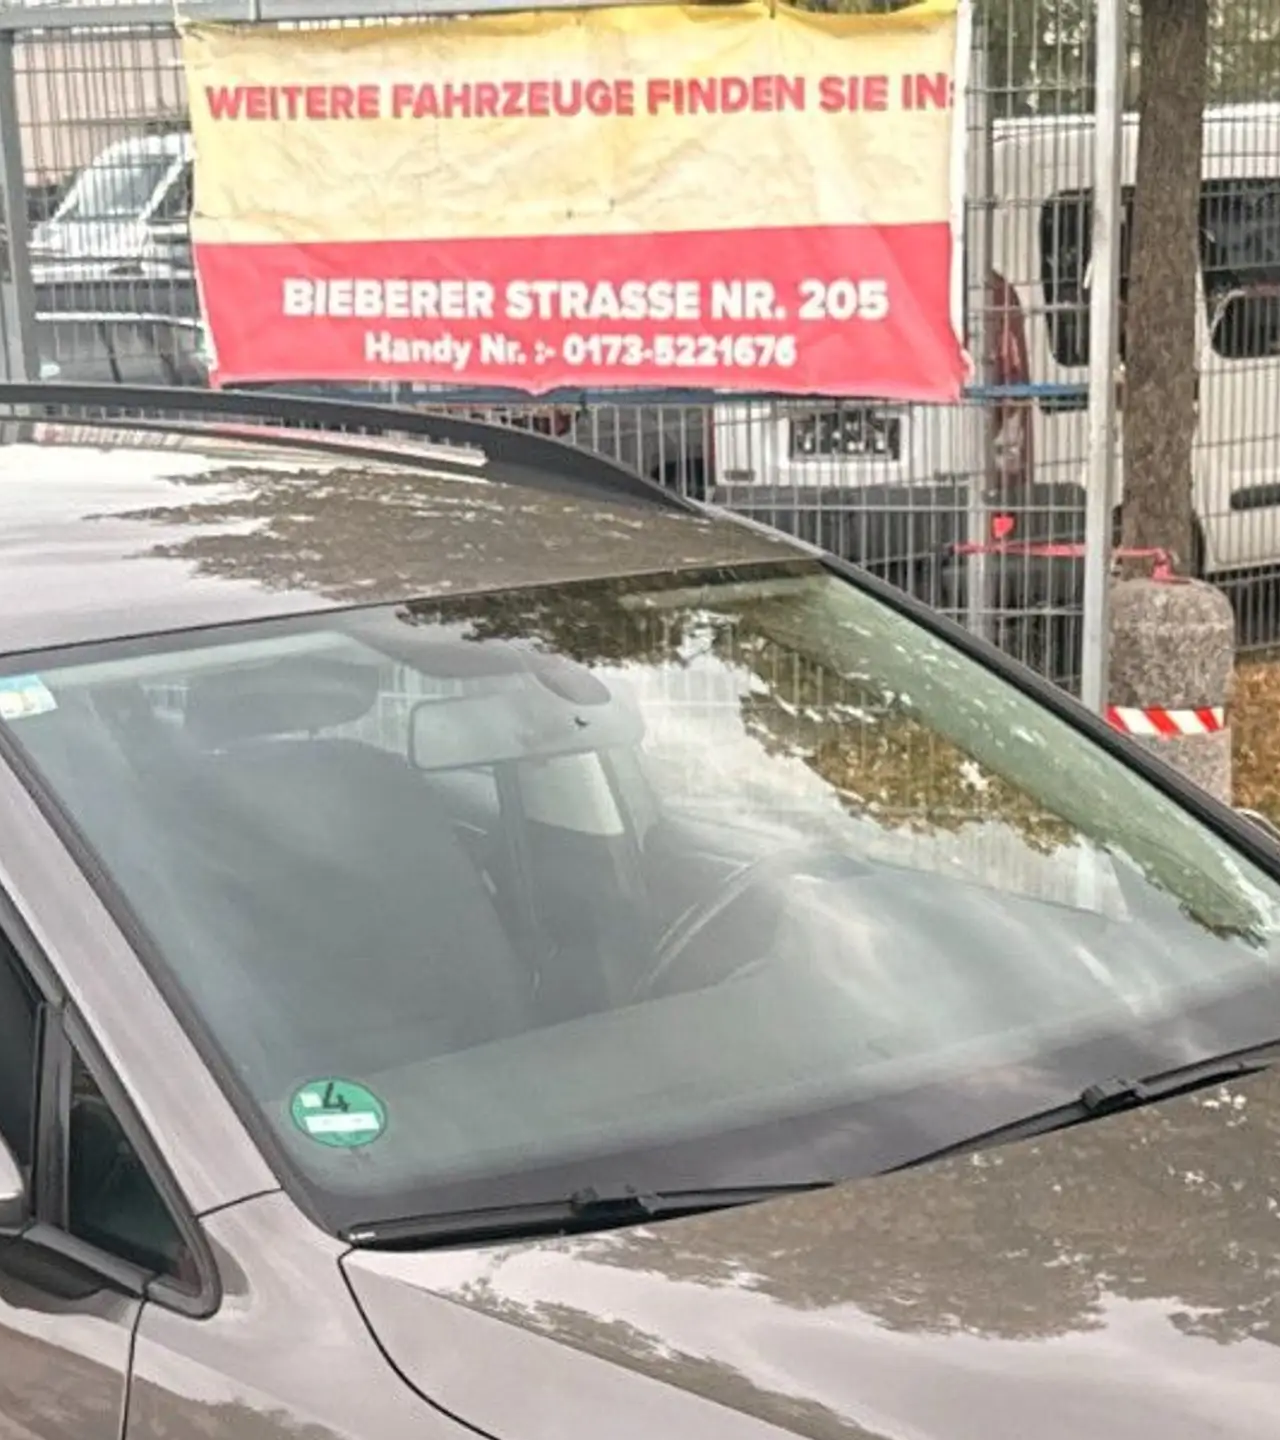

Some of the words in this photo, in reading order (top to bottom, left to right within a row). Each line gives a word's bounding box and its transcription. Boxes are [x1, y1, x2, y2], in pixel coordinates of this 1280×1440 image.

[205, 83, 380, 120] WEITERE
[392, 79, 634, 119] FAHRZEUGE
[646, 74, 806, 115] FINDEN
[819, 74, 889, 113] SIE
[282, 277, 495, 319] BIEBERER
[505, 278, 701, 320] STRASSE
[710, 279, 787, 320] NR.
[798, 277, 890, 320] 205
[364, 331, 472, 371] Handy
[480, 332, 526, 364] Nr.
[563, 333, 798, 367] 0173-5221676
[322, 1081, 349, 1113] 4
